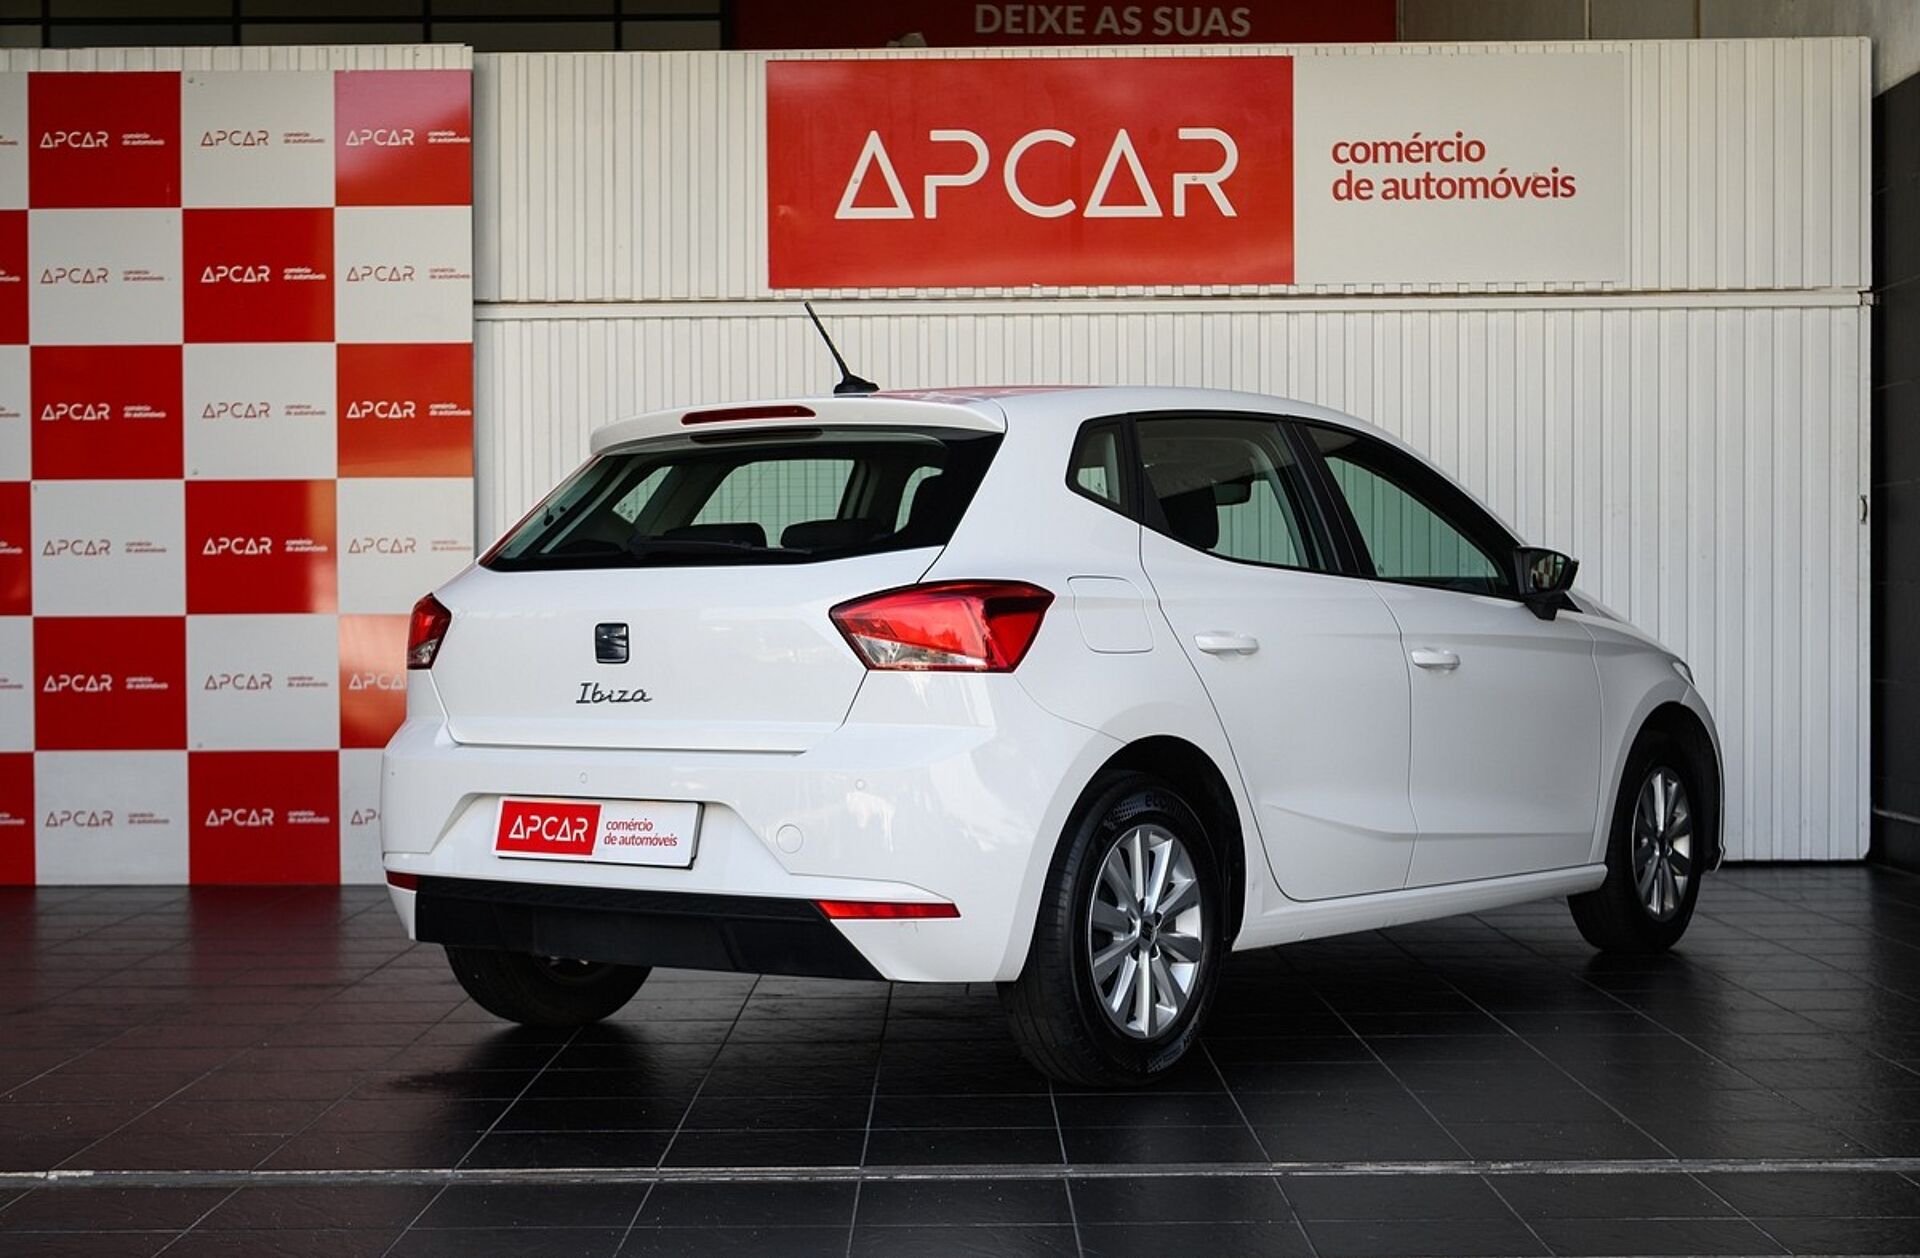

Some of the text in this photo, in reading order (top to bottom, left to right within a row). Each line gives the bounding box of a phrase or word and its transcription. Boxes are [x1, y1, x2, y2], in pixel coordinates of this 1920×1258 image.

[976, 5, 1250, 36] DEIXE AS SUAS
[40, 131, 108, 148] APCAR
[201, 130, 268, 146] APCAR
[345, 129, 414, 146] APCAR
[1333, 132, 1485, 164] comércio
[835, 128, 1238, 219] APCAR
[1333, 167, 1576, 201] de automóveis
[41, 268, 108, 284] APCAR
[201, 266, 270, 283] APCAR
[346, 266, 414, 281] APCAR
[41, 403, 110, 420] APCAR
[202, 402, 270, 419] APCAR
[347, 401, 415, 418] APCAR
[43, 539, 110, 556] APCAR
[203, 537, 272, 555] APCAR
[348, 538, 416, 554] APCAR
[44, 674, 112, 692] APCAR
[205, 674, 272, 690] APCAR
[349, 674, 407, 690] APCA
[576, 683, 652, 703] Ibiza
[46, 810, 113, 827] APCAR
[206, 808, 274, 826] APCAR
[605, 818, 654, 833] comércio
[508, 815, 589, 842] APCAR
[603, 832, 678, 848] de automóveis
